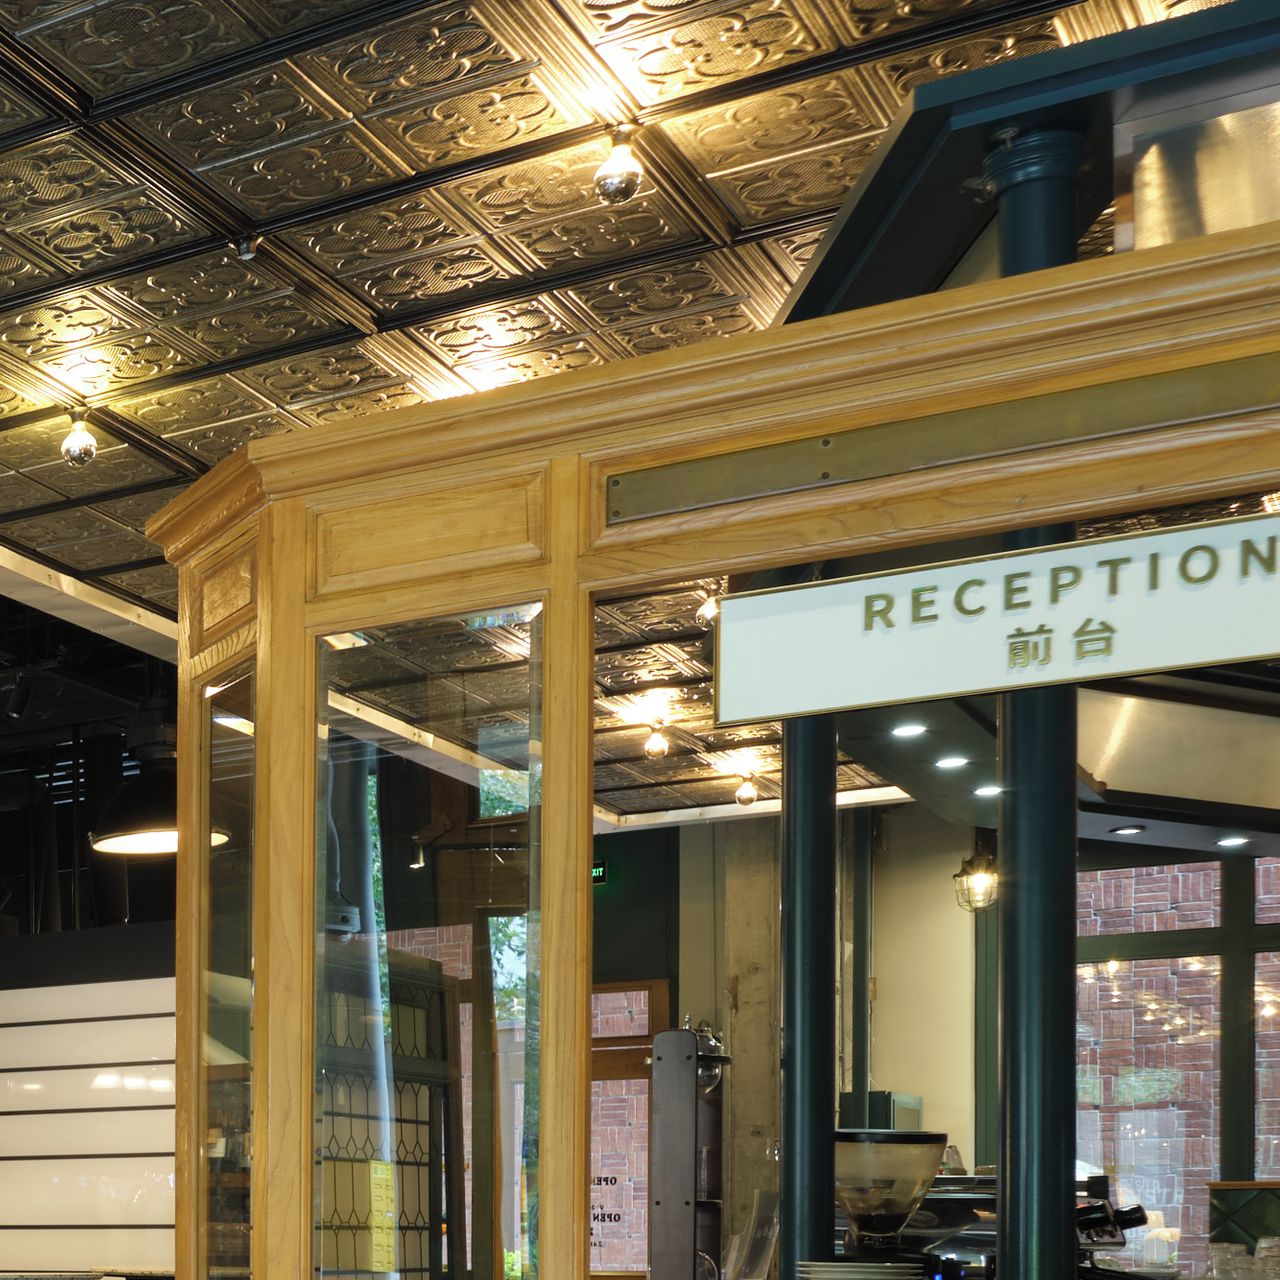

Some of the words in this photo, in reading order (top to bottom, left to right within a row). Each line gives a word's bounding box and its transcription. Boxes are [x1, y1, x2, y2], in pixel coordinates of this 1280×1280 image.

[864, 535, 1277, 632] RECEPTION
[1006, 617, 1117, 668] 前台
[591, 867, 604, 877] XIT
